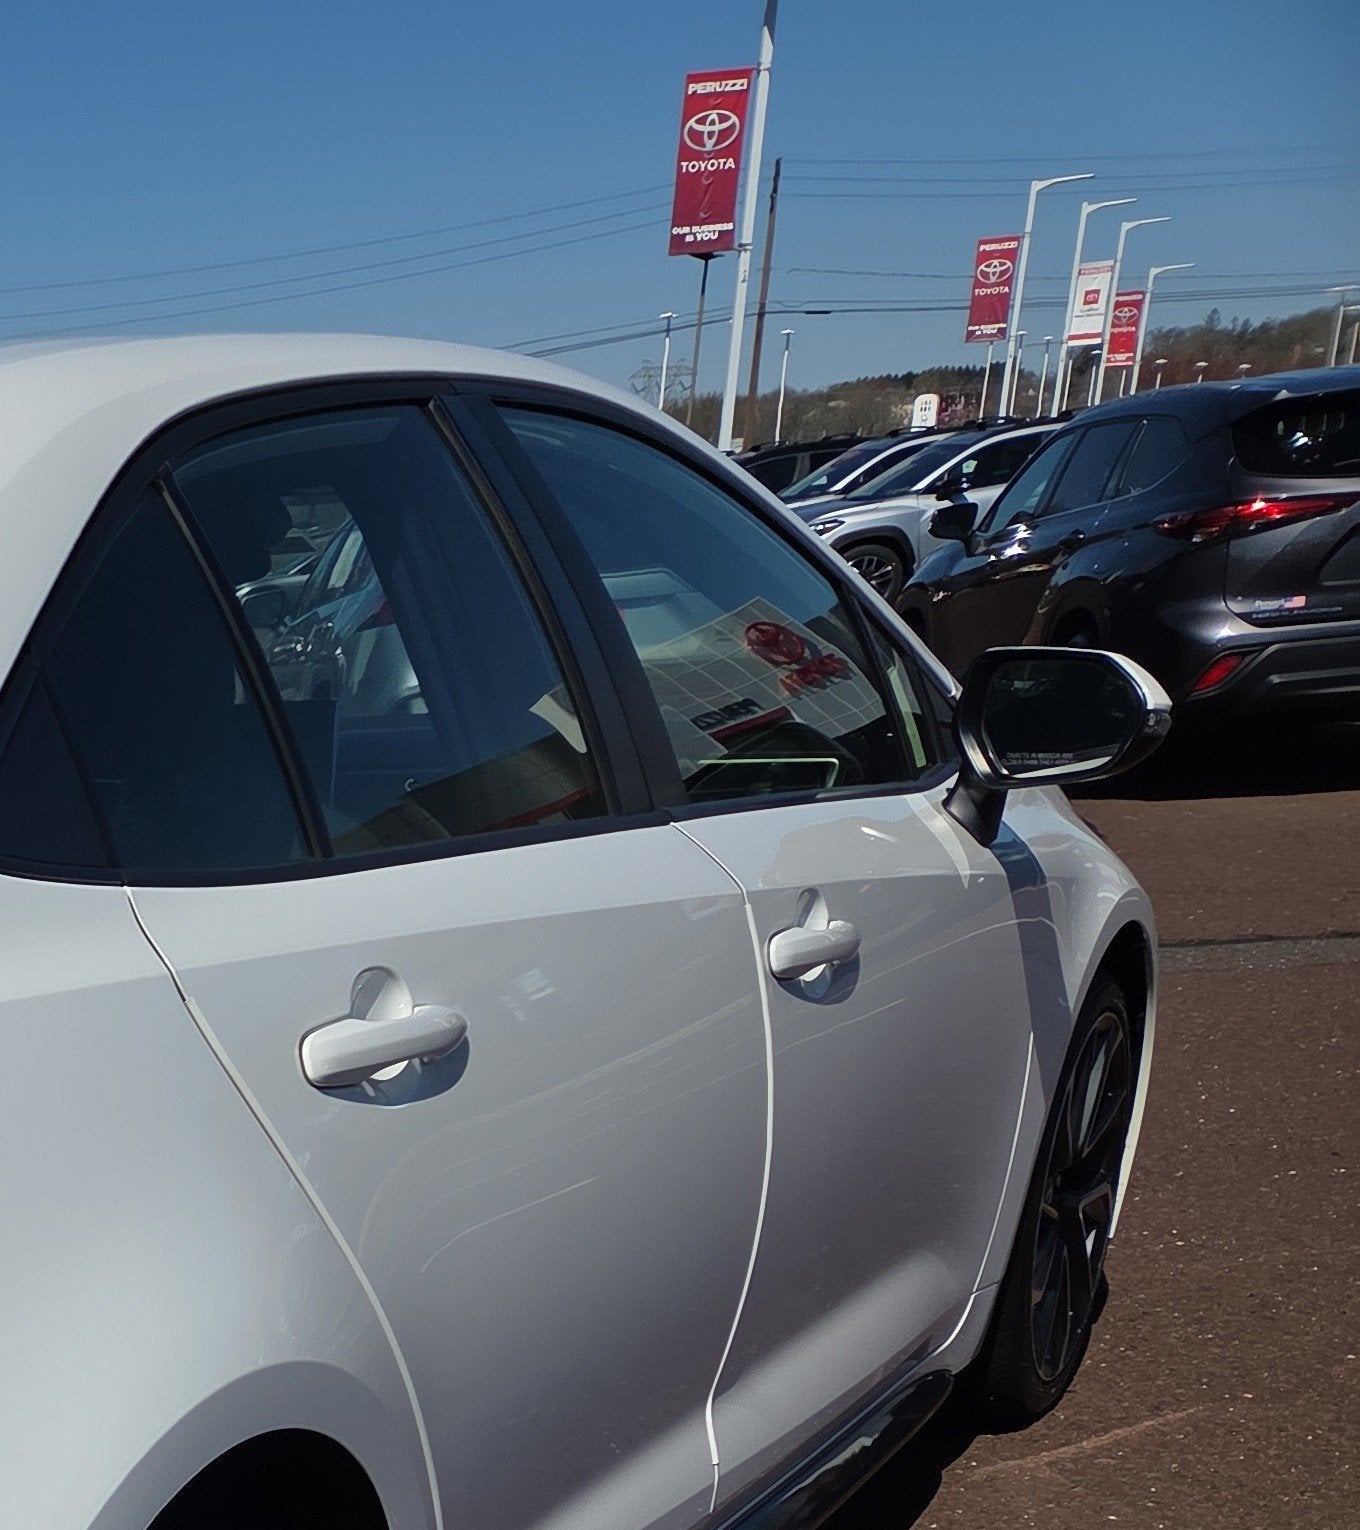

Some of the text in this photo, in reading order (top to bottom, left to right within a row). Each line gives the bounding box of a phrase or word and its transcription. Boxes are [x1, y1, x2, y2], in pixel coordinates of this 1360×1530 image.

[688, 79, 748, 94] PERUZZI
[680, 158, 735, 173] TOYOTA
[696, 230, 719, 241] YOU
[975, 286, 1010, 296] TOYOTA
